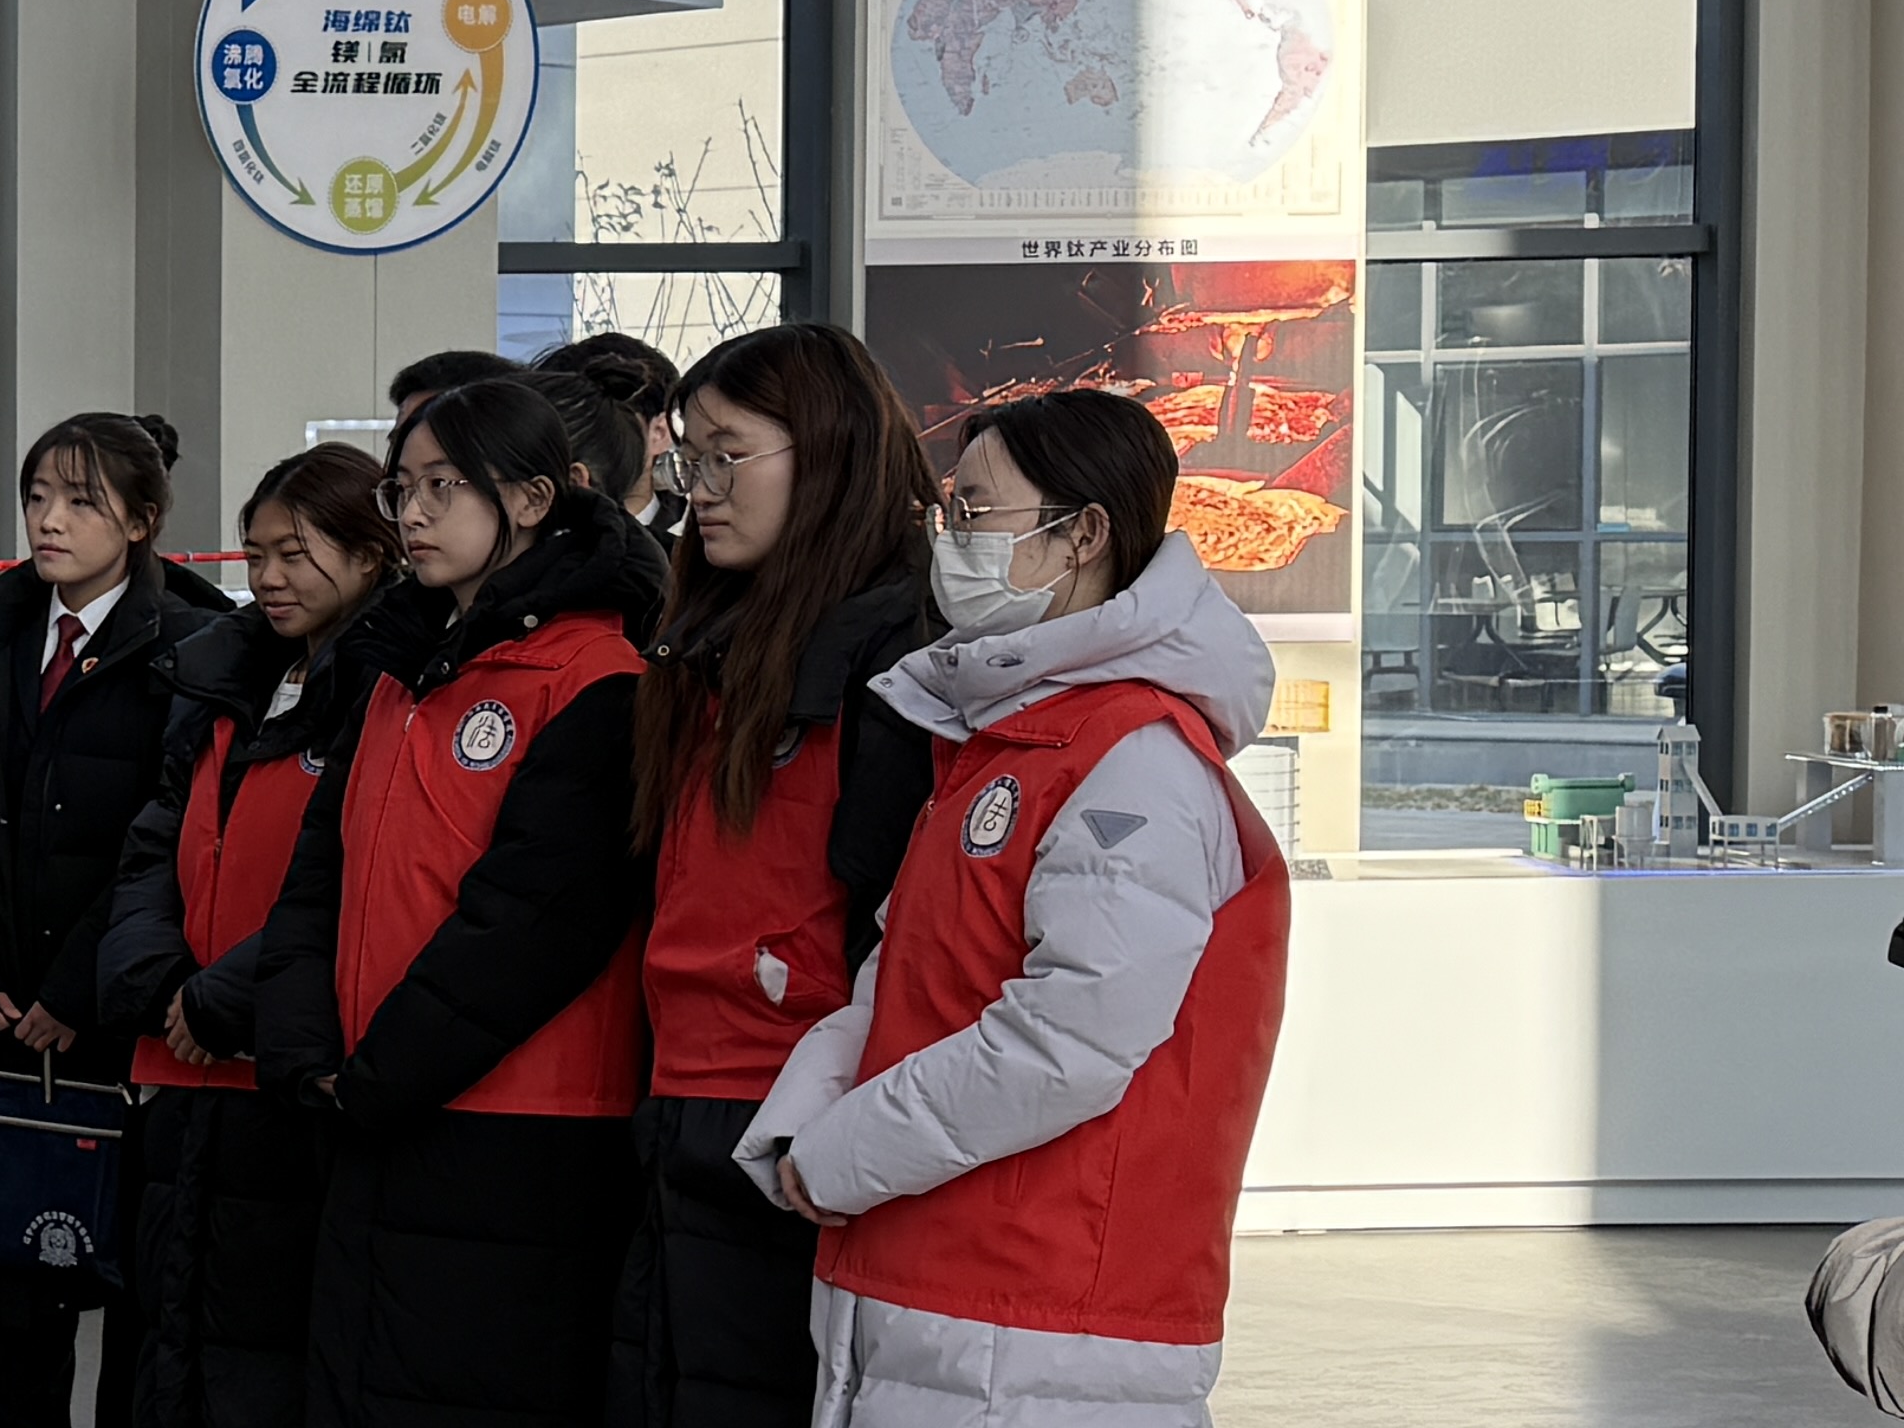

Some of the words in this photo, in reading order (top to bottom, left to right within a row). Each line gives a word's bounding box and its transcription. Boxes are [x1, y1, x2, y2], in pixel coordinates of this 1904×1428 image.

[322, 9, 413, 34] 海绵钛
[290, 71, 444, 95] 全流程循环
[1022, 239, 1199, 259] 世界钛产业分布图
